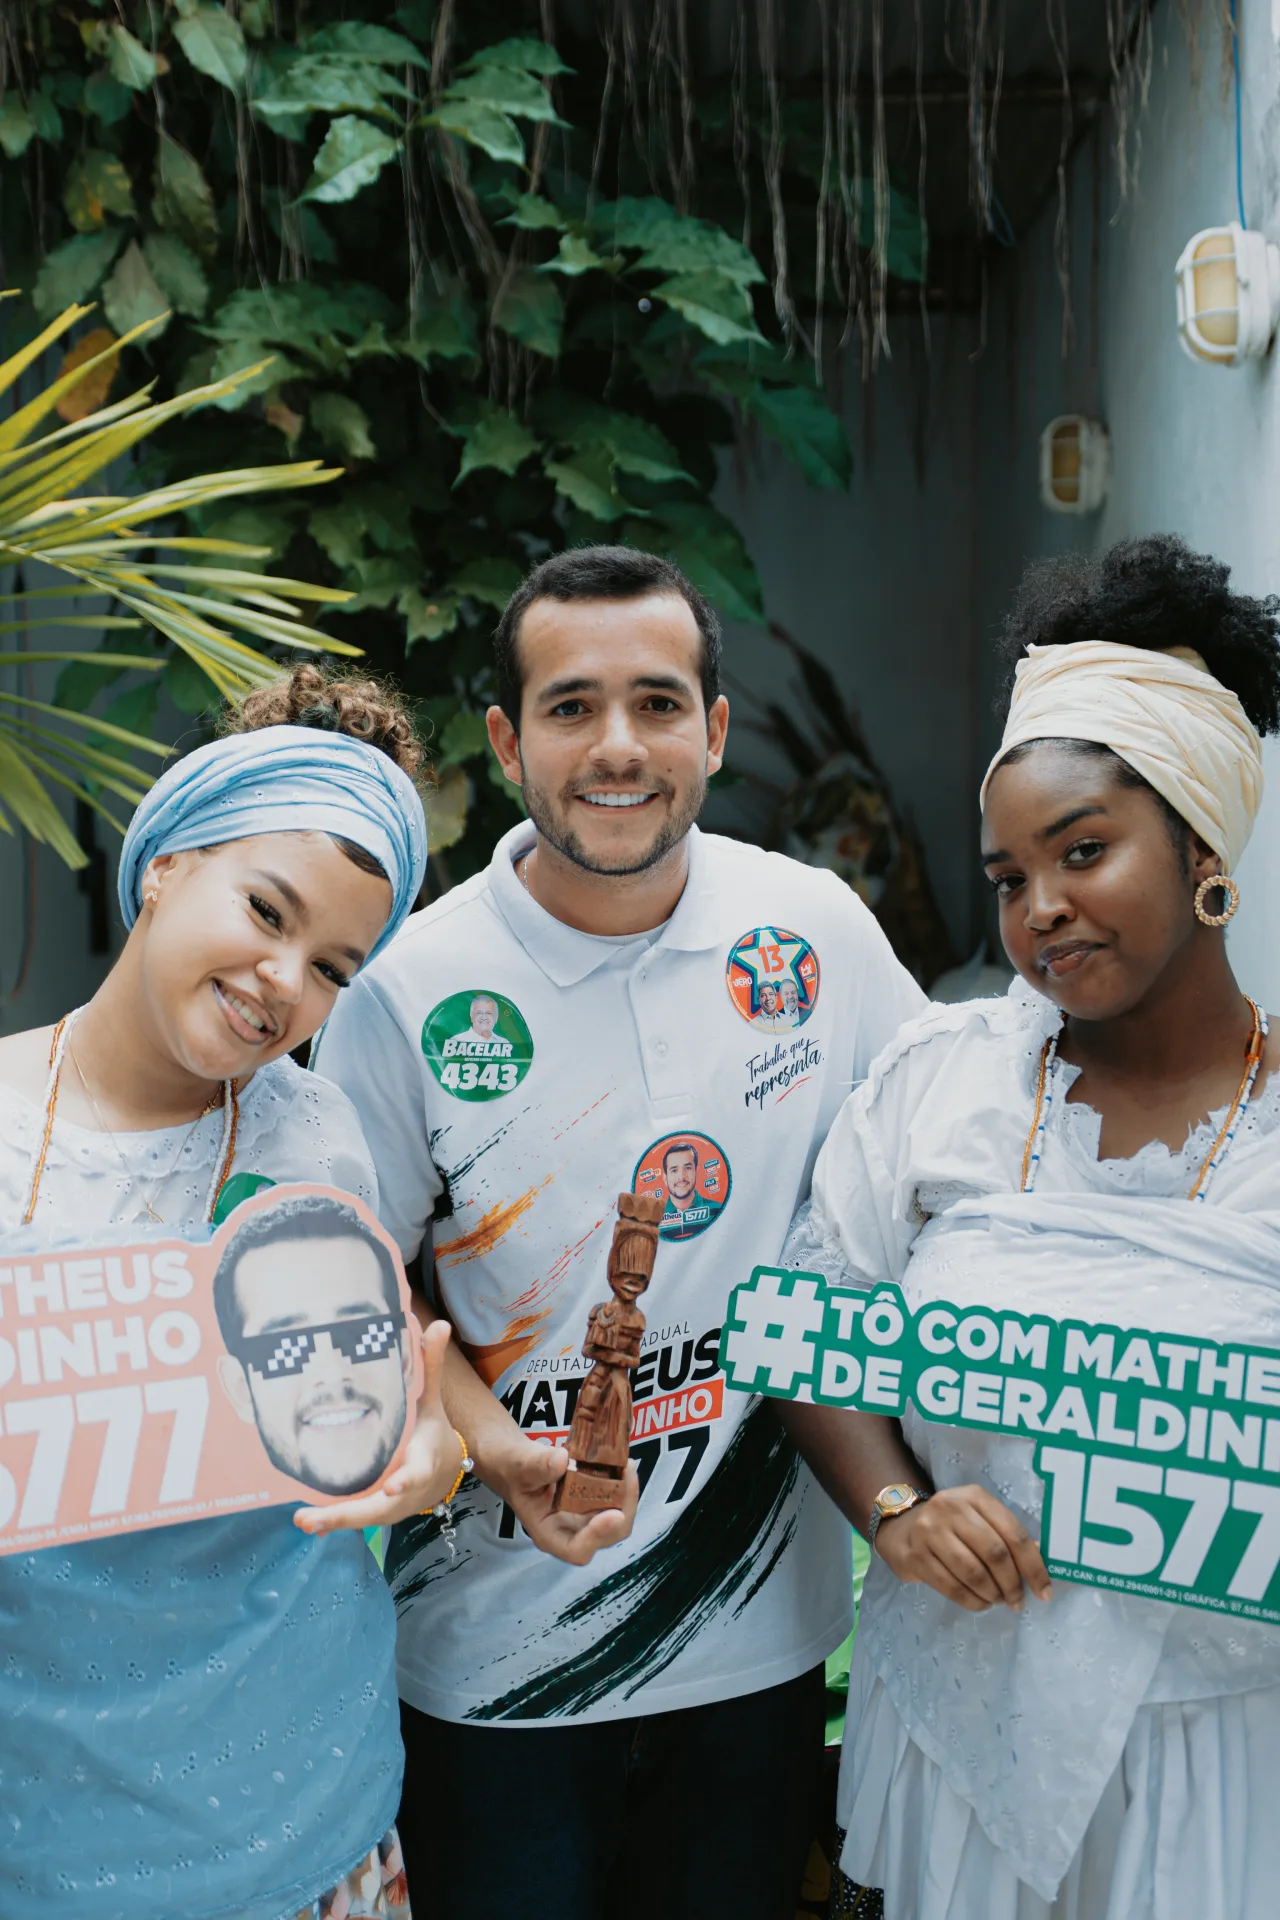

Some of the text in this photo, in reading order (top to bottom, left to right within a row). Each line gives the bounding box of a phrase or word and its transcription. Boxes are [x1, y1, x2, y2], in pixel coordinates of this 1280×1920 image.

[757, 944, 785, 974] 13
[441, 1039, 514, 1058] BACELAR
[745, 1037, 805, 1083] Trabalho que
[440, 1062, 519, 1091] 4343
[684, 1209, 707, 1221] 15777
[526, 1321, 691, 1373] DEPUTAD ADUAL
[917, 1309, 1050, 1370] COM
[1063, 1329, 1280, 1407] MATHE
[819, 1349, 903, 1407] DE
[1040, 1446, 1280, 1602] 1577
[1047, 1564, 1072, 1578] CNPJ
